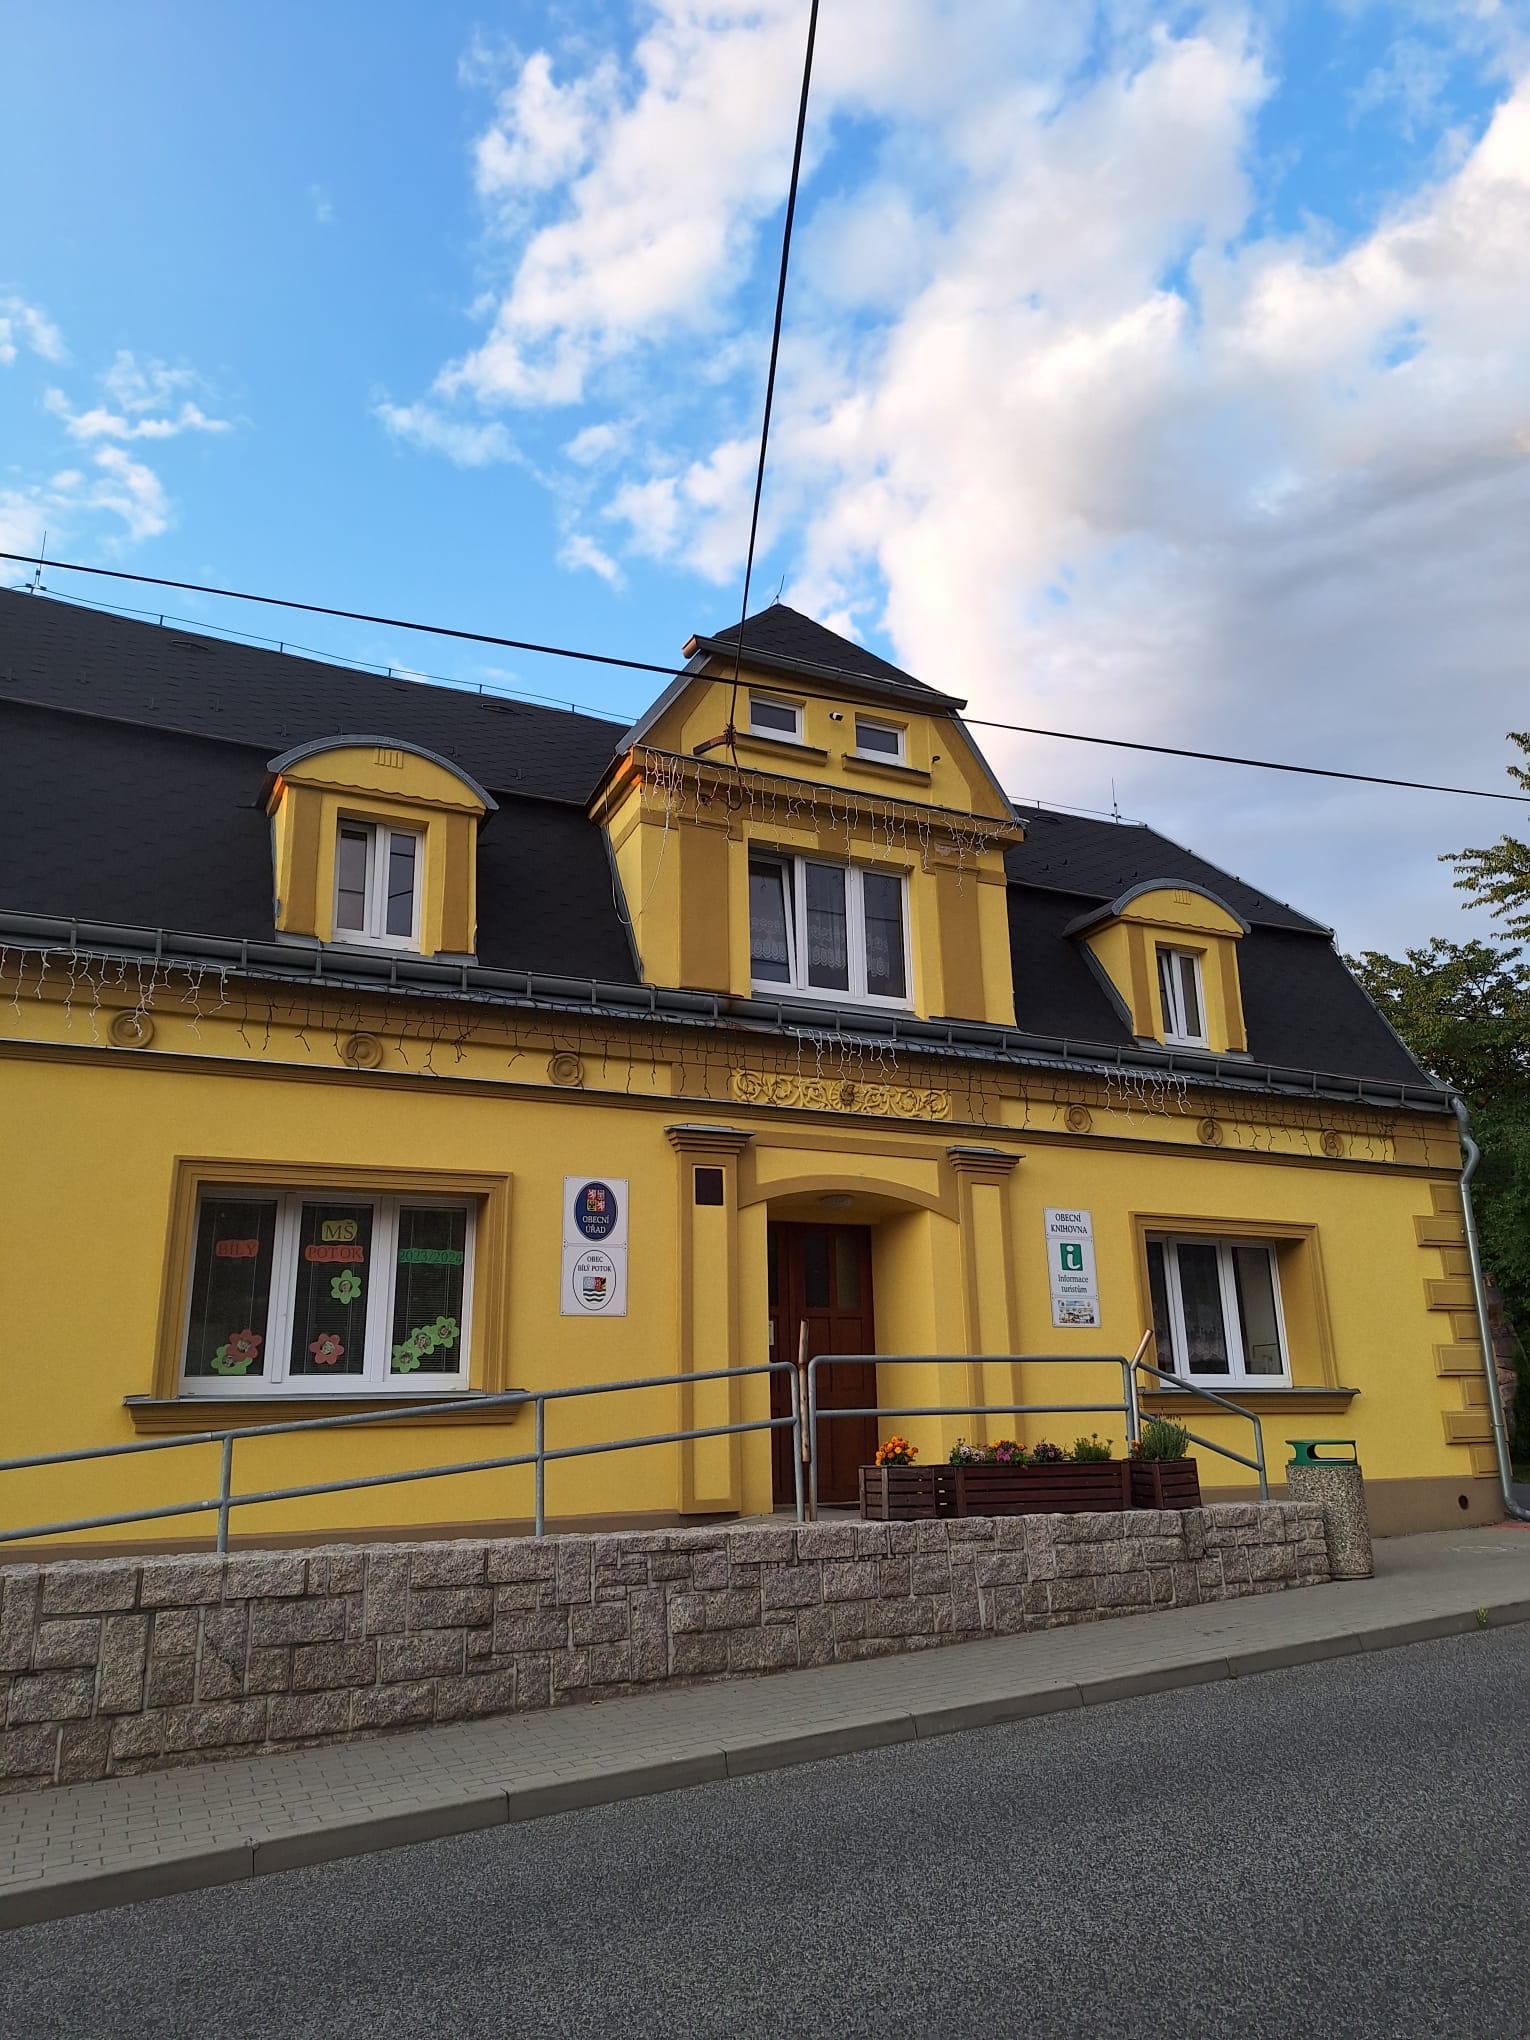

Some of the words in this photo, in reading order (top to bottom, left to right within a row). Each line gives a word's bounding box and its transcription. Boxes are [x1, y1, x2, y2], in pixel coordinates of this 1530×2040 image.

[582, 1215, 609, 1223] OBECNÍ
[1055, 1213, 1081, 1222] OBECNÍ
[325, 1220, 354, 1240] MŠ
[586, 1224, 606, 1233] ÚŘAD
[1050, 1224, 1088, 1234] KNIHOVNA
[308, 1246, 362, 1260] POTOK
[1057, 1274, 1089, 1283] Informace
